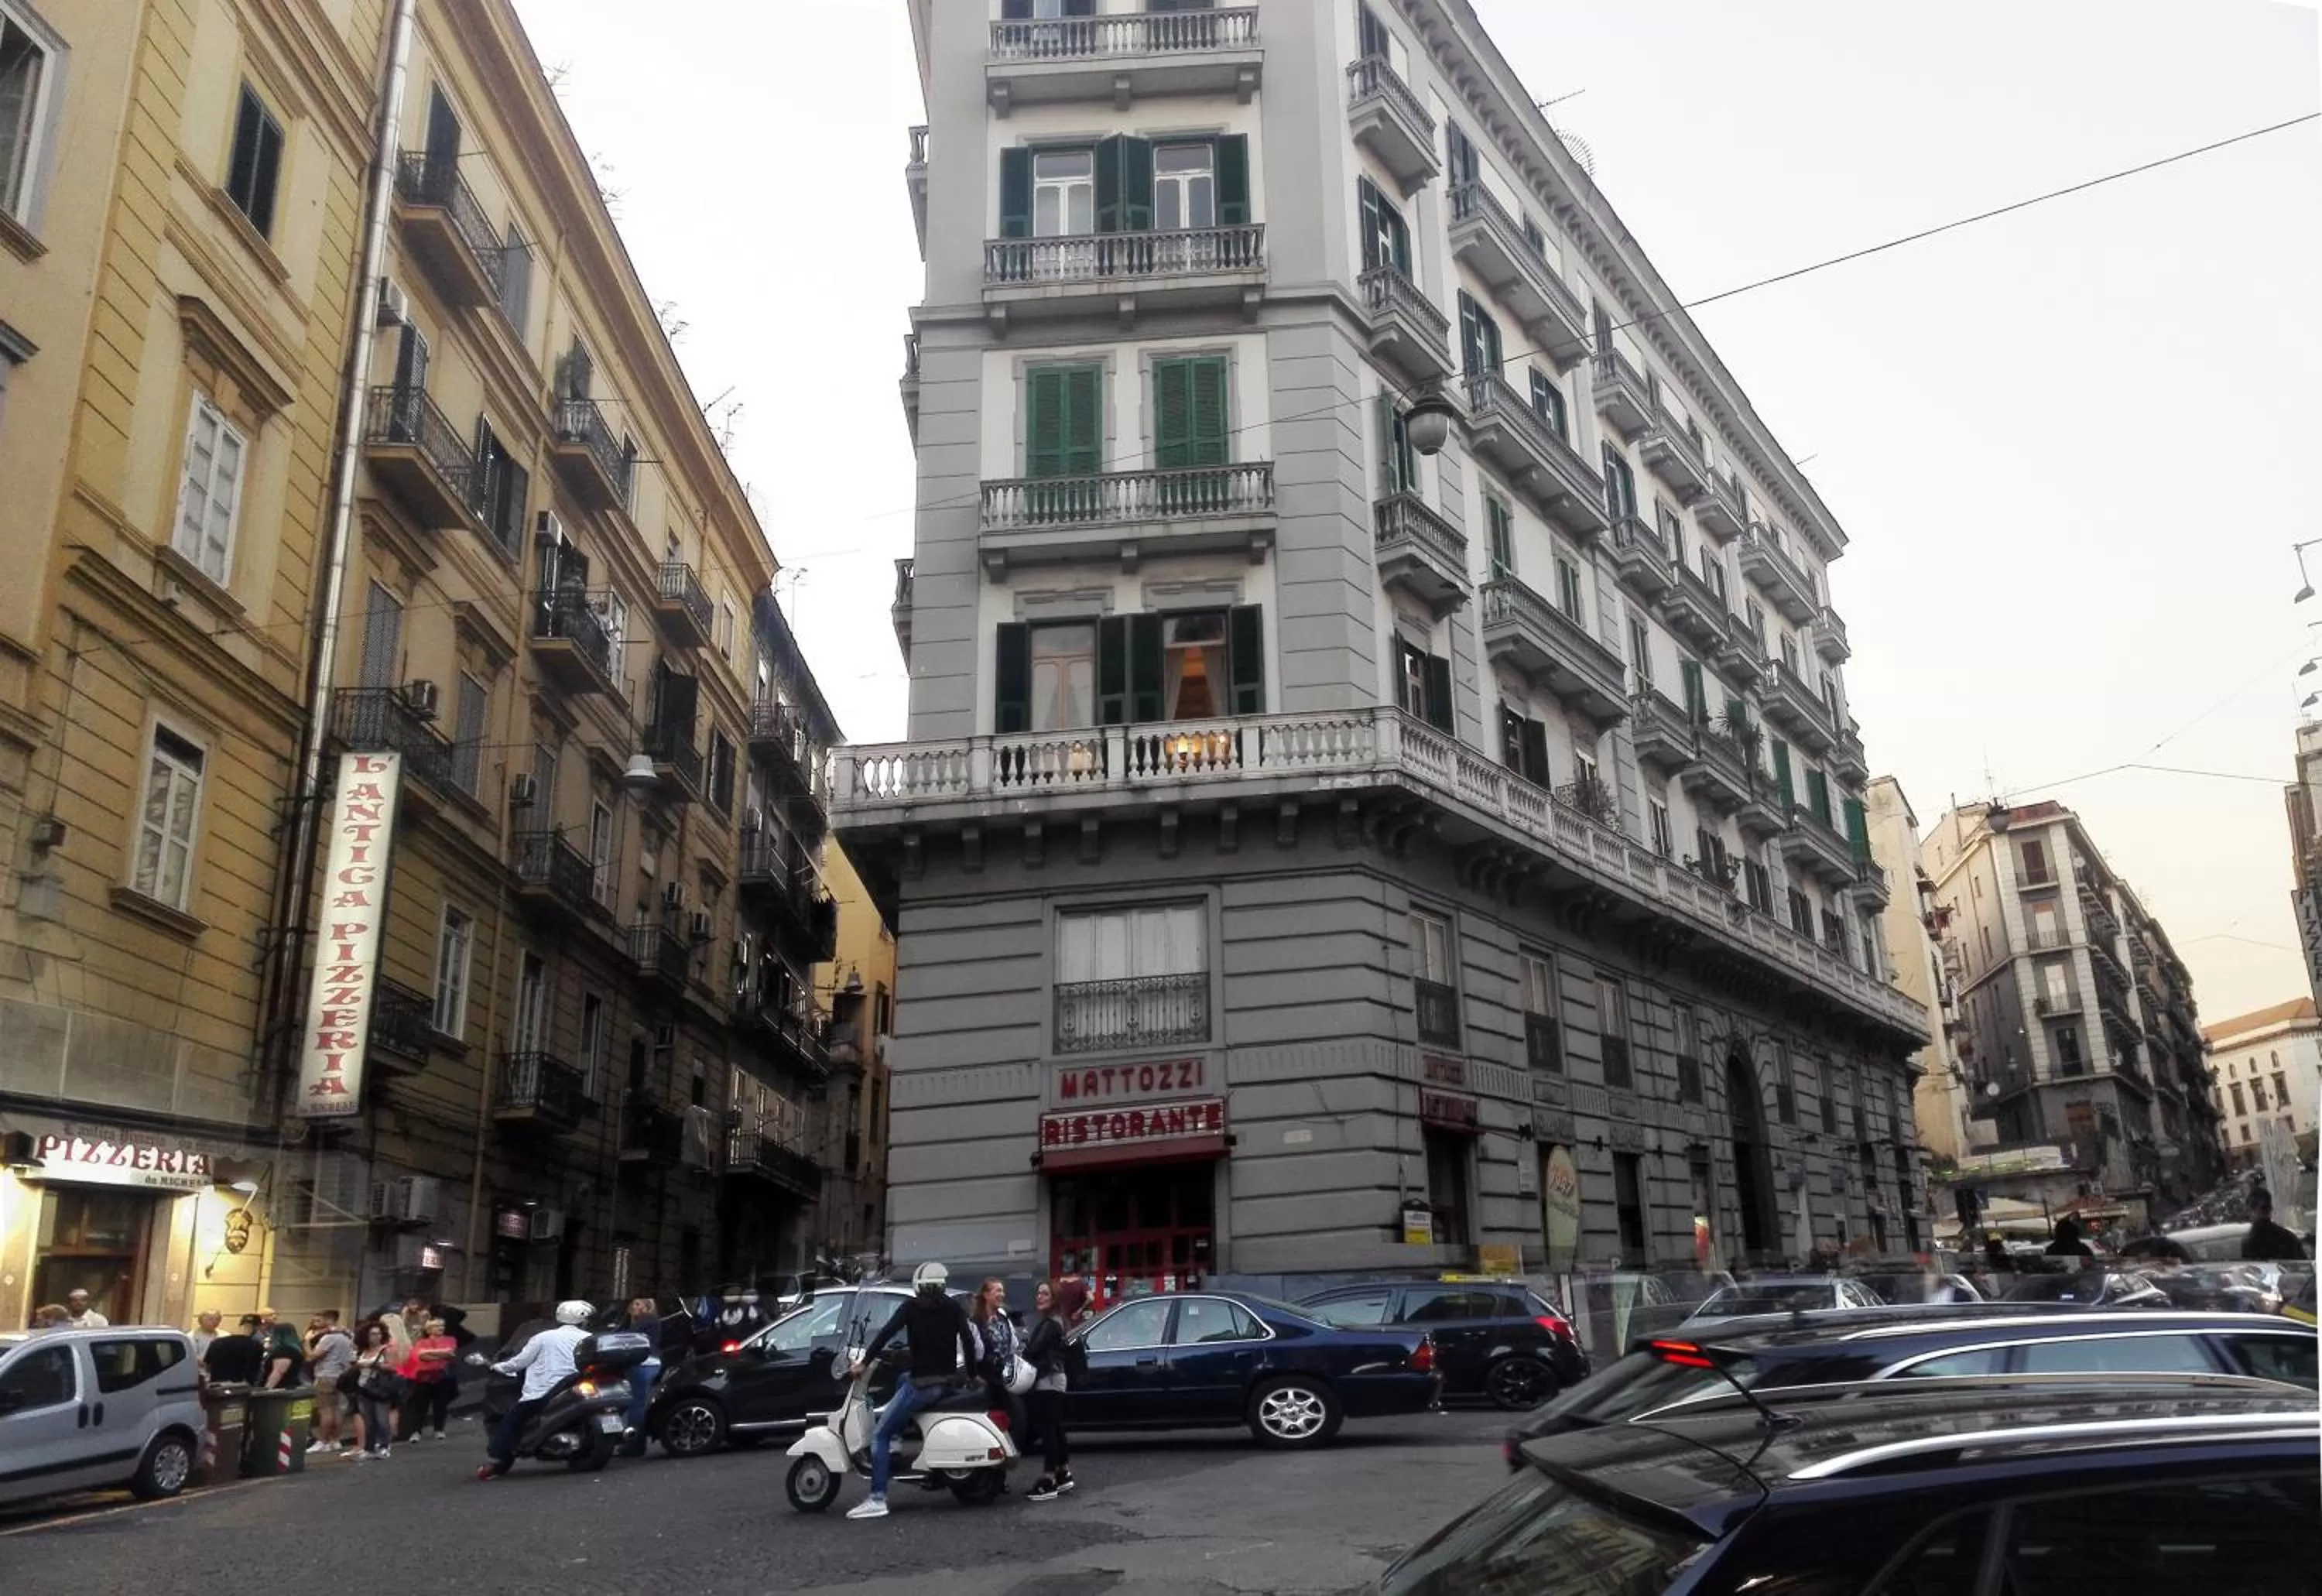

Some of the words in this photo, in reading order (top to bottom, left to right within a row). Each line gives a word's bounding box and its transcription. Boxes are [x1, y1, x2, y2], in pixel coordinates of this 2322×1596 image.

[309, 922, 369, 1097] PIZZERIA
[1060, 1060, 1203, 1100] MATTOZZI
[1044, 1102, 1223, 1146] RISTORANTE
[36, 1132, 212, 1176] PIZZERIA
